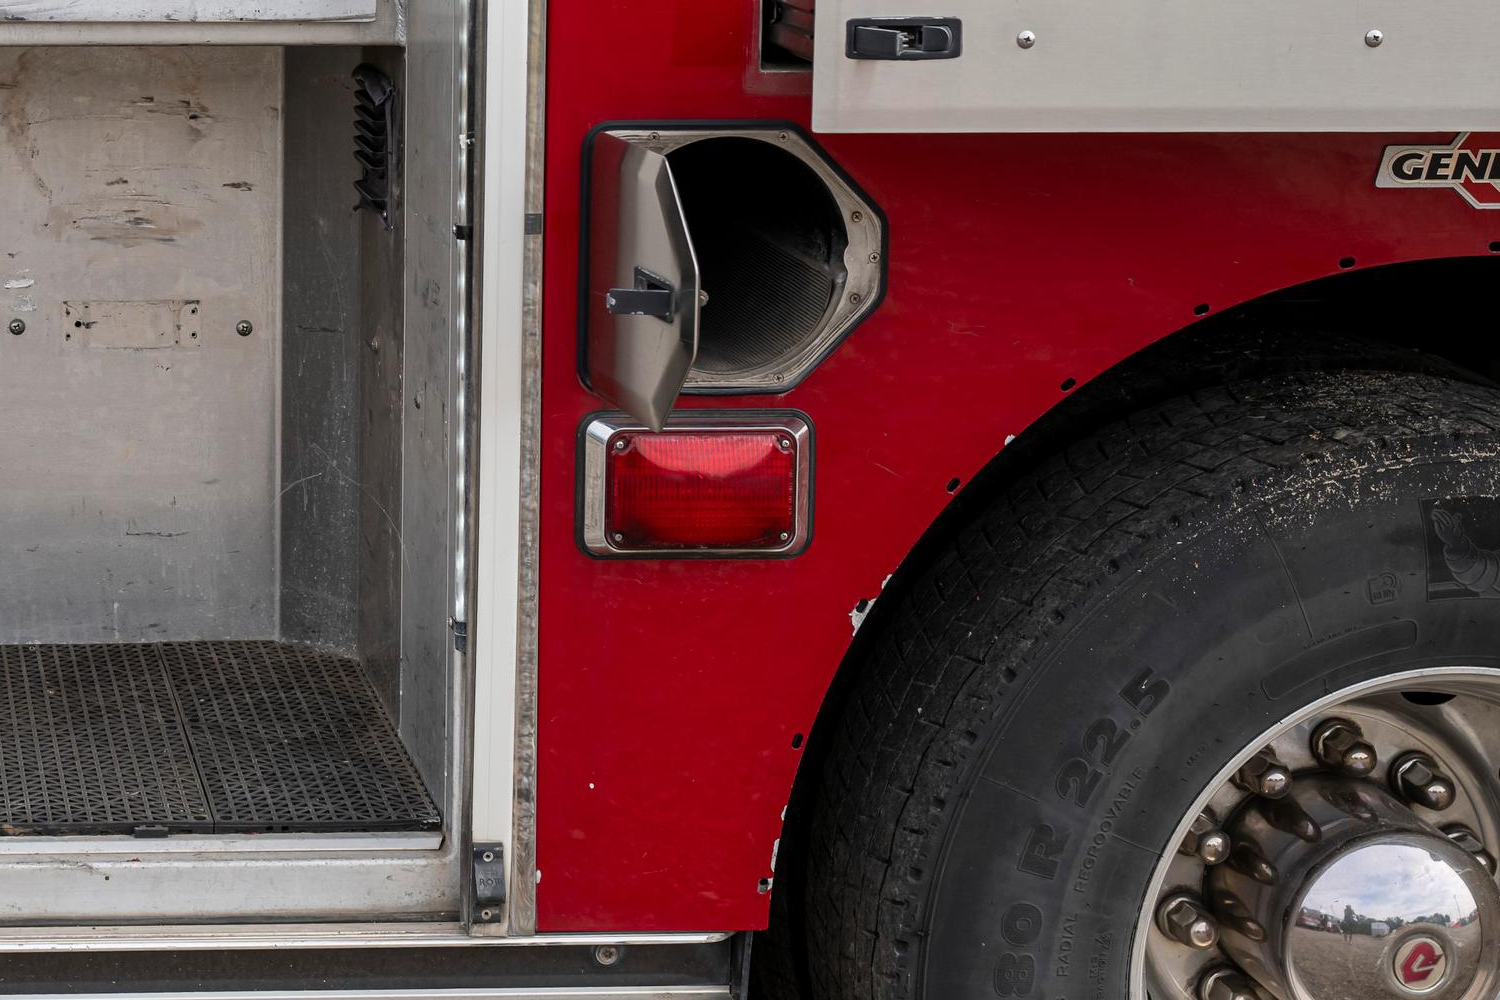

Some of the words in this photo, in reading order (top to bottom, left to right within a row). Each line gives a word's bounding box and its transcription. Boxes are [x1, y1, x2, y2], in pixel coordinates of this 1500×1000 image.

[1055, 665, 1171, 809] 22.5
[1055, 912, 1079, 978] RADIAL
[1073, 766, 1146, 894] REGROOVABLE
